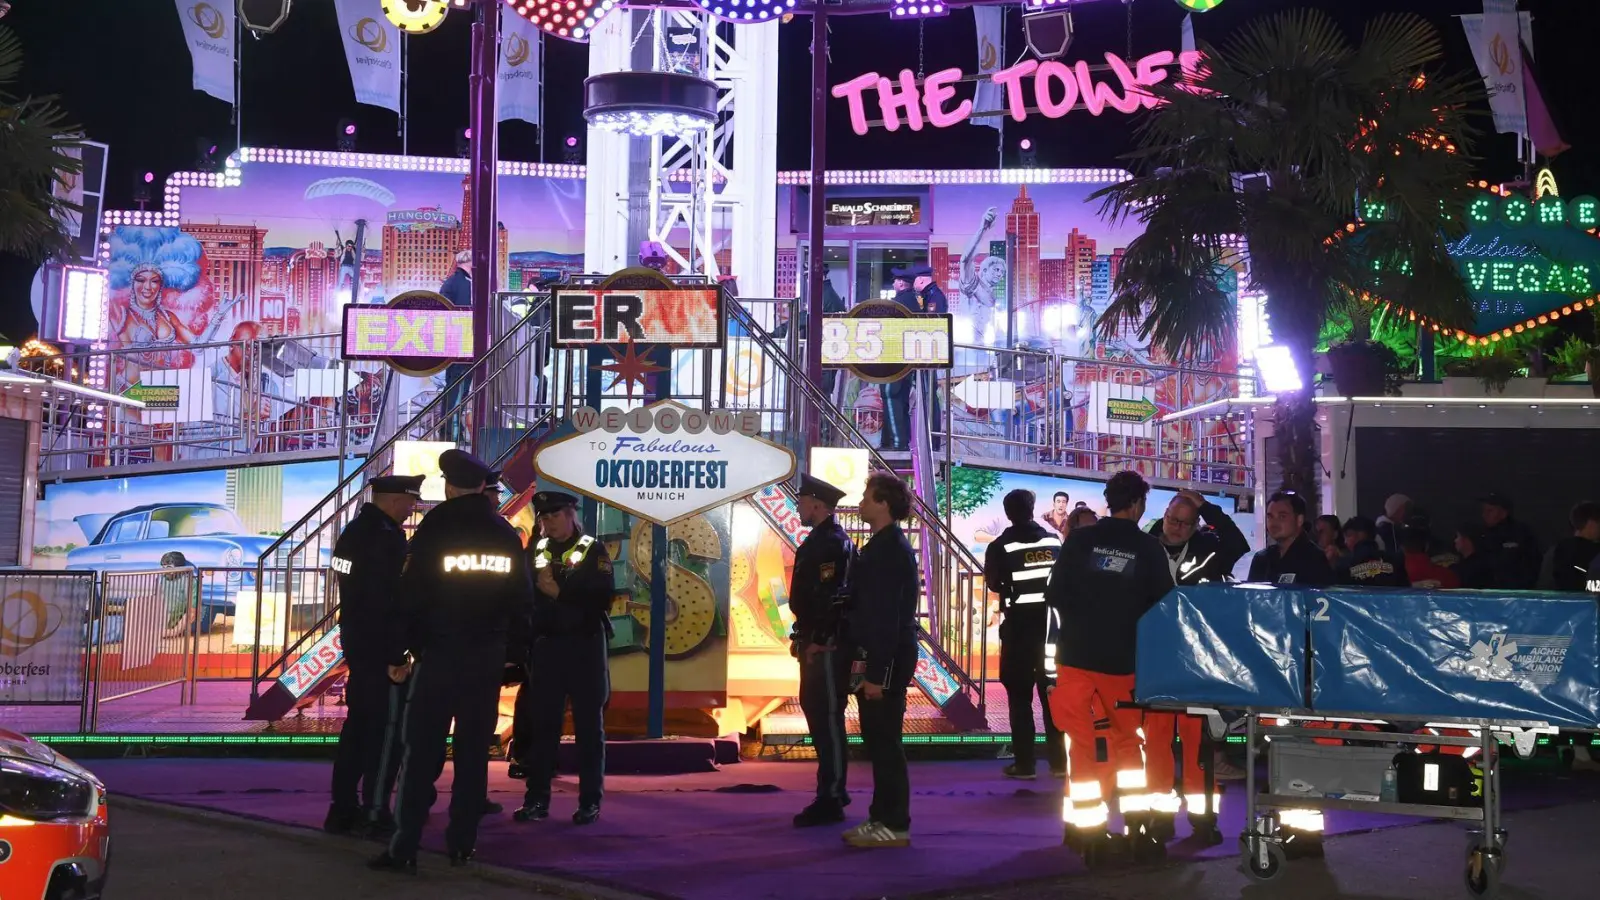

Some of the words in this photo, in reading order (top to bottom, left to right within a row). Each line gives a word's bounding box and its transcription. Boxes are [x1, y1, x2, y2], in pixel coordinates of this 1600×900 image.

[831, 68, 972, 136] THE
[388, 211, 457, 223] HANGOVER
[832, 203, 863, 214] EWALD
[1466, 262, 1592, 294] VEGAS
[558, 294, 647, 340] ER
[356, 314, 473, 354] EXIT
[822, 320, 883, 361] 85
[903, 329, 949, 361] m
[130, 388, 180, 396] ENTRANCE
[1108, 400, 1153, 411] ENTRANCE
[576, 411, 755, 432] WELCOME
[589, 441, 607, 451] TO
[612, 436, 721, 456] Fabulous
[595, 459, 729, 489] OKTOBERFEST
[636, 491, 686, 501] MUNICH
[1025, 549, 1053, 563] GGS
[1114, 549, 1136, 560] Service
[443, 553, 512, 574] POLIZEI
[1313, 597, 1331, 622] 2
[1511, 654, 1566, 664] AMBULANZ
[1530, 647, 1568, 656] AICHER
[1530, 664, 1562, 673] UNION
